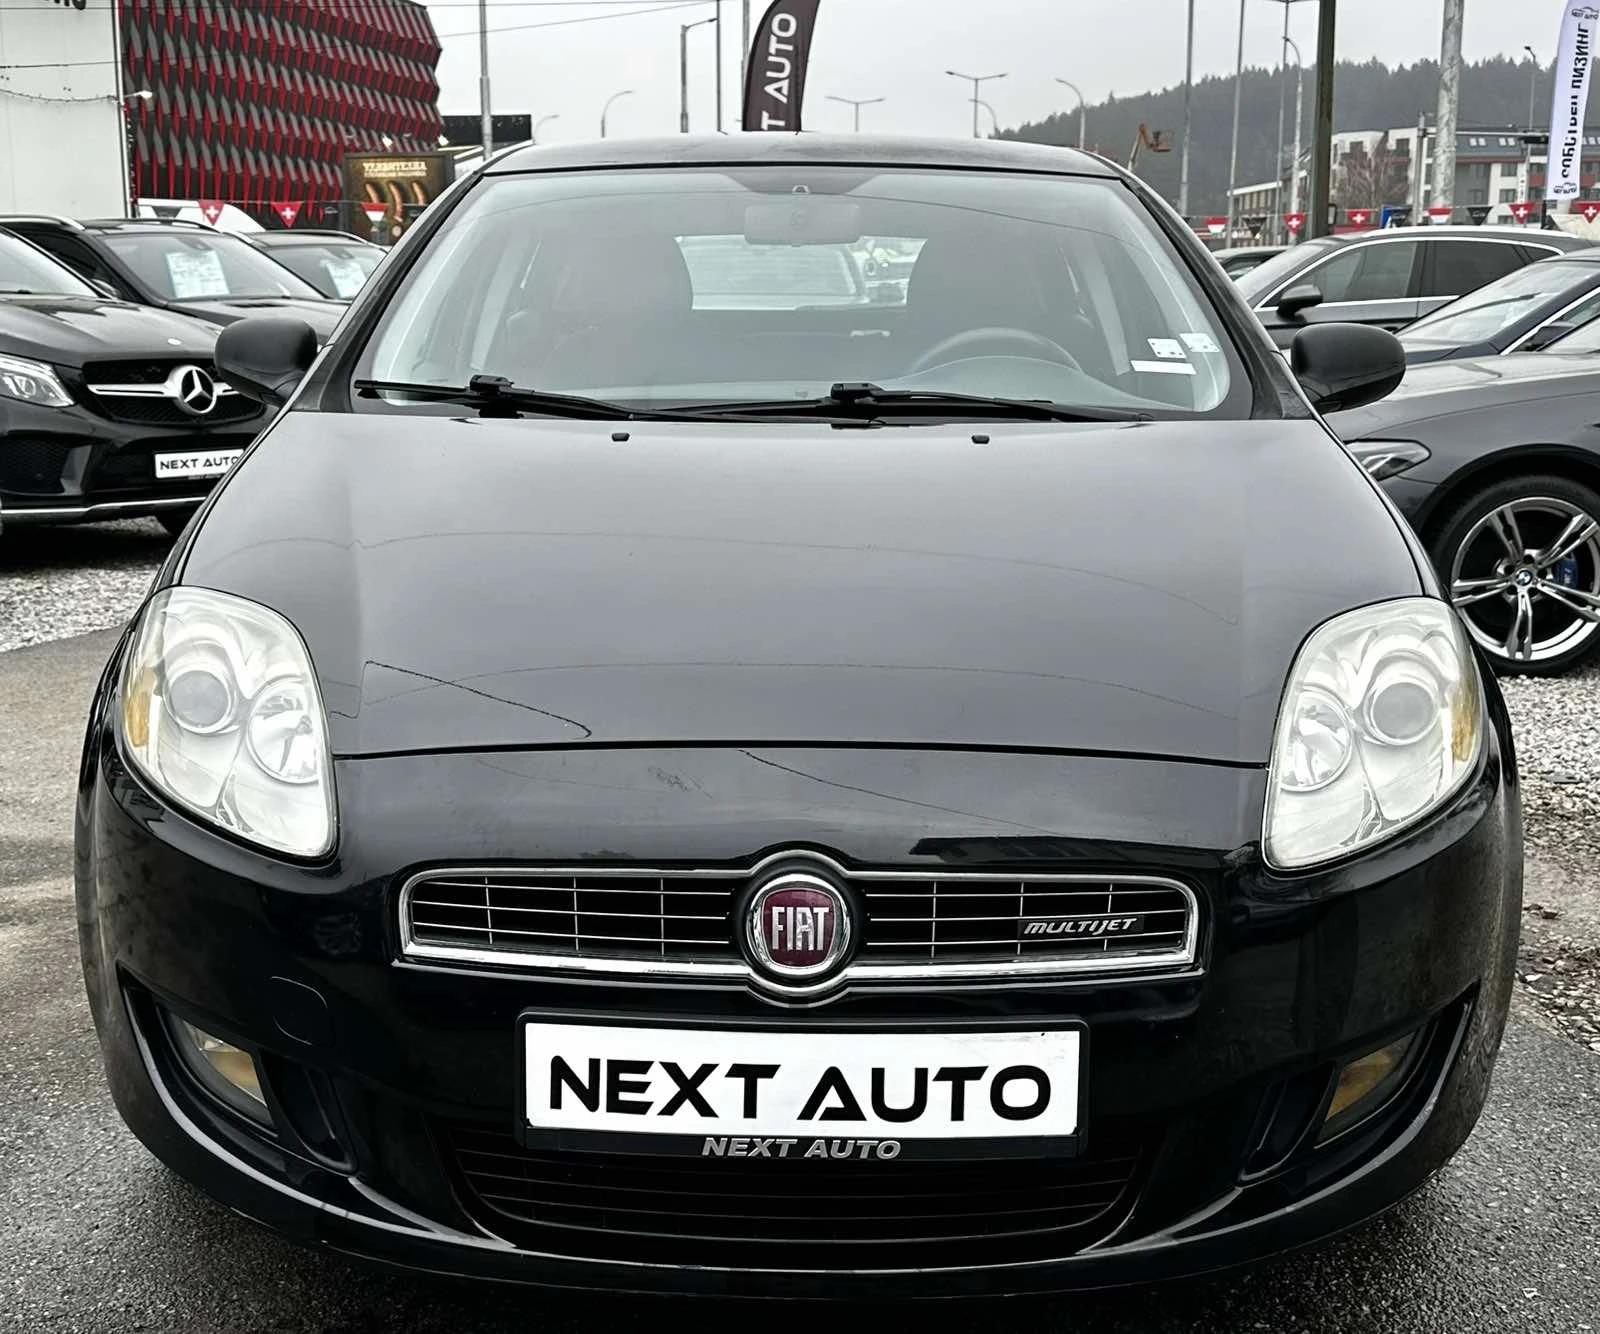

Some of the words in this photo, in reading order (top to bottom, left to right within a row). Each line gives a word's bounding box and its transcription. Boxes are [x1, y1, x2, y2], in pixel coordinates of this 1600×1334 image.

[763, 12, 798, 105] AUTO
[160, 458, 199, 470] NEXT
[771, 906, 830, 951] FIAT
[1023, 918, 1138, 936] MULTIJET
[549, 1054, 782, 1119] NEXT
[796, 1064, 1052, 1123] AUTO
[702, 1137, 798, 1158] NEXT
[803, 1139, 901, 1161] AUTO
